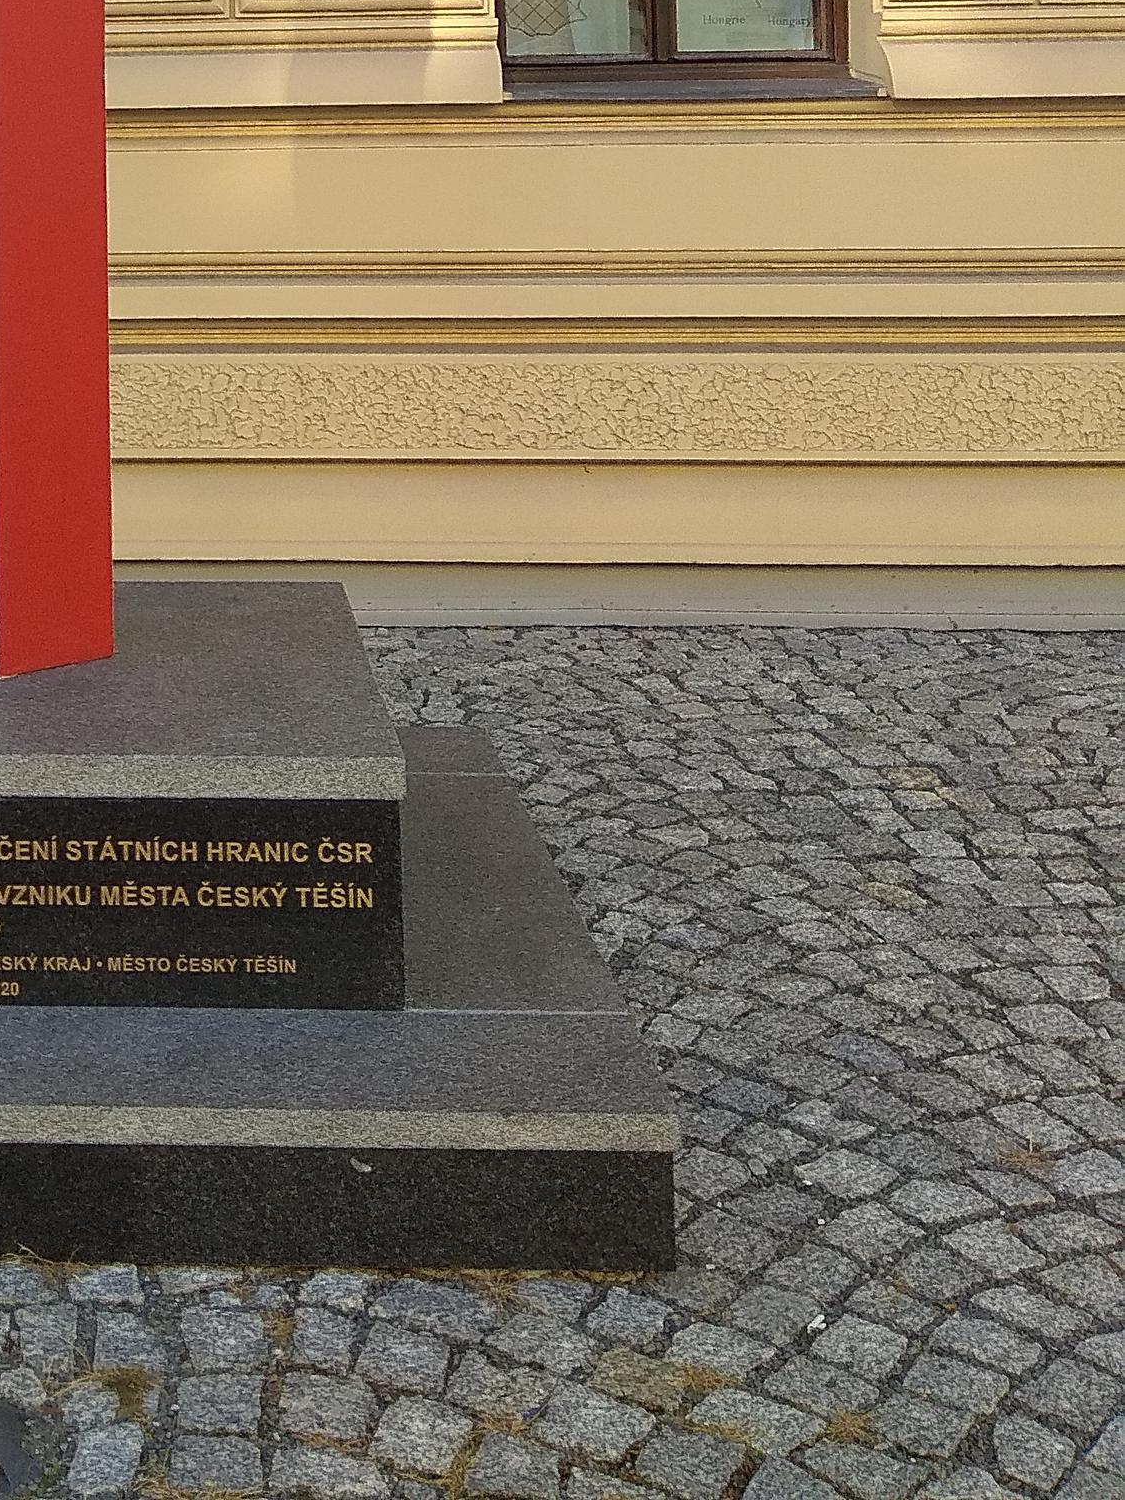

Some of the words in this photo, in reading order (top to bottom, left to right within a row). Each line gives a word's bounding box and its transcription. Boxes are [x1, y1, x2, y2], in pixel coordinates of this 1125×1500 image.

[66, 835, 198, 862] STÁTNÍCH
[206, 841, 309, 863] HRANIC
[317, 836, 373, 863] ČSR
[100, 880, 190, 907] MĚSTA
[197, 881, 288, 908] ČESKÝ
[295, 882, 373, 909] TĚŠÍN
[43, 956, 91, 972] KRAJ
[107, 952, 171, 972] MĚSTO
[176, 953, 237, 973] ČESKÝ
[244, 954, 297, 973] TĚŠÍN
